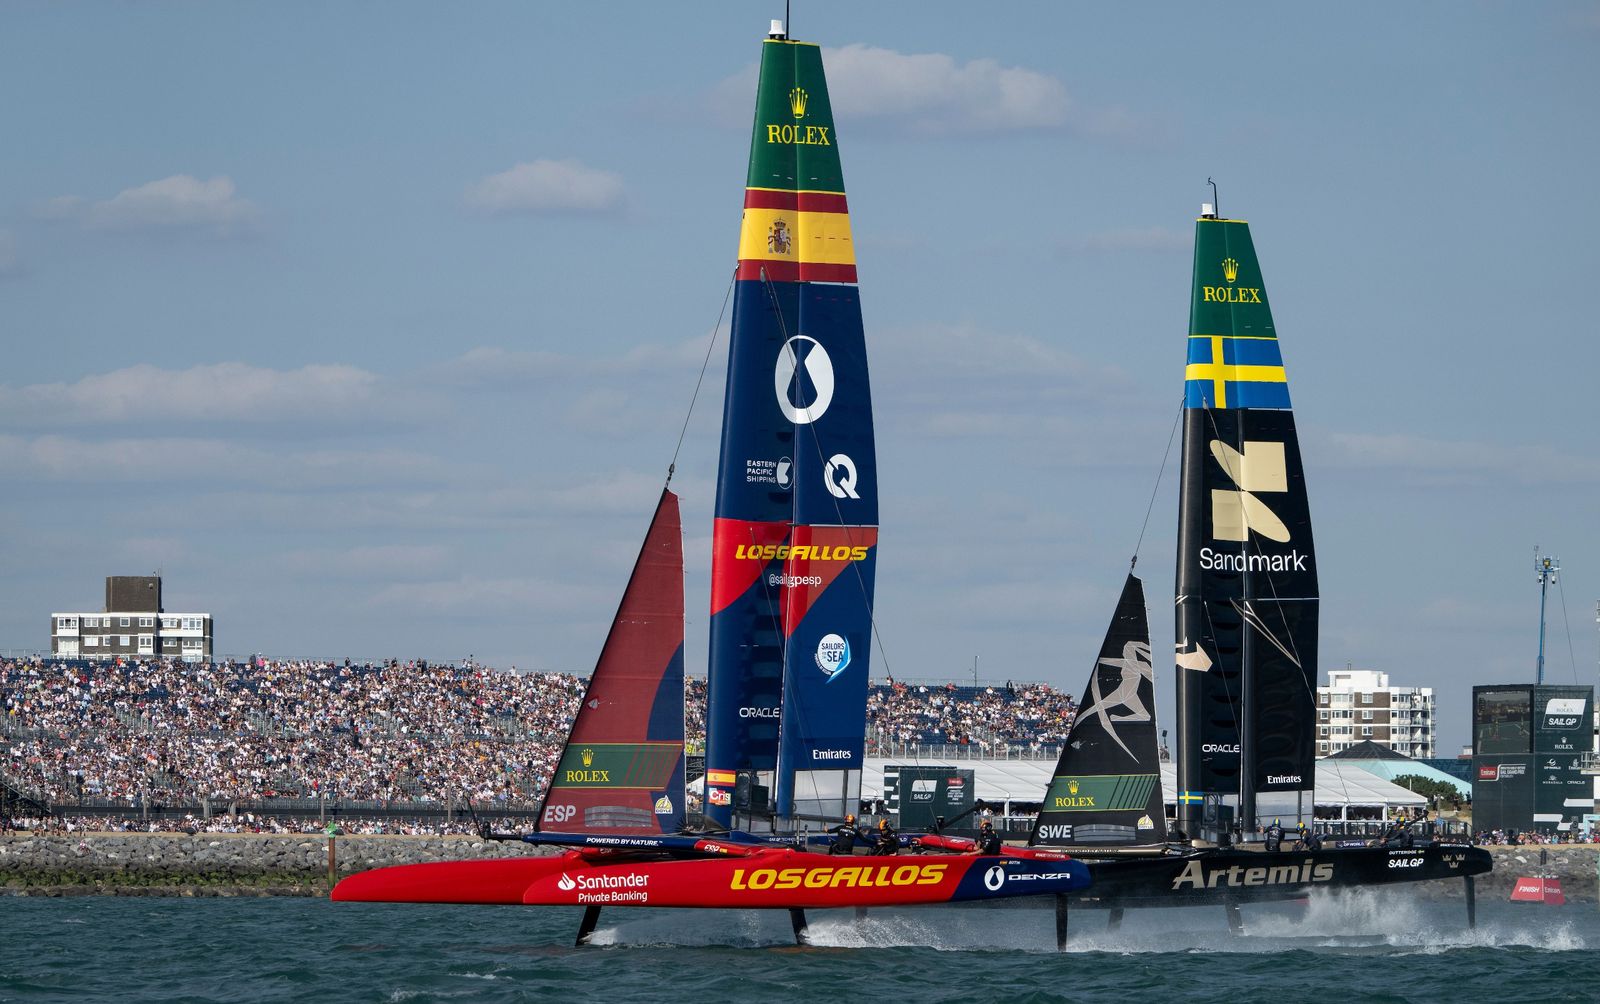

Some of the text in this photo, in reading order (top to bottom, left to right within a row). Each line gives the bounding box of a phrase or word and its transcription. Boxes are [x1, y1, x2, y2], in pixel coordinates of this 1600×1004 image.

[766, 124, 830, 146] ROLEX
[1203, 286, 1262, 304] ROLEX
[746, 459, 777, 468] EASTERN
[746, 468, 773, 476] PACIFIC
[746, 475, 776, 484] SHIPPING
[735, 544, 869, 561] LOSGALLOS
[1199, 547, 1307, 573] Sandmark
[768, 573, 822, 588] @sailgpesp
[821, 642, 845, 651] SAILORS
[826, 651, 844, 663] SEA
[739, 707, 780, 718] ORACLE
[1202, 743, 1240, 753] ORACLE
[812, 749, 852, 760] Emirates
[566, 770, 610, 782] ROLEX
[1267, 774, 1302, 785] Emirates
[1055, 796, 1095, 807] ROLEX
[544, 805, 577, 822] ESP
[1038, 824, 1072, 839] SWE
[586, 837, 620, 845] POWERED
[730, 864, 949, 891] LOSGALLOS
[1008, 872, 1071, 881] DENZA
[1171, 858, 1334, 890] Artemis
[577, 872, 650, 890] Santander
[578, 891, 648, 903] Private Banking
